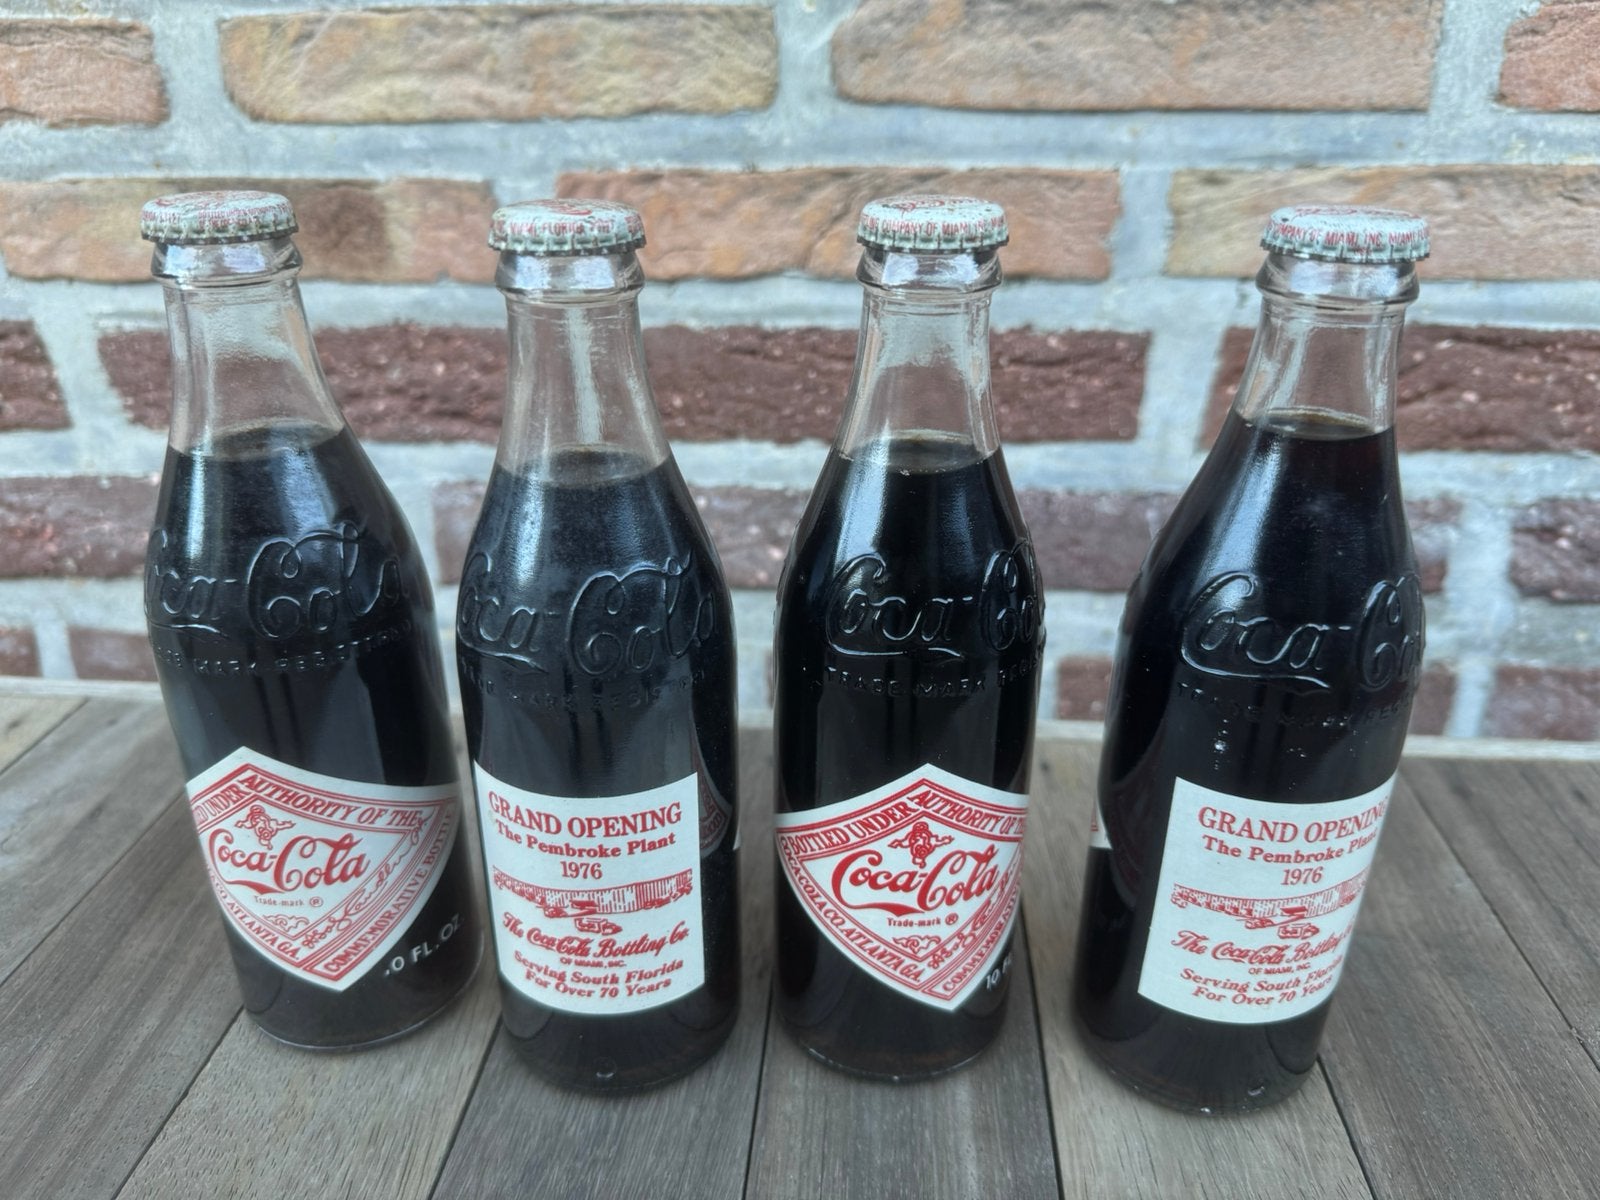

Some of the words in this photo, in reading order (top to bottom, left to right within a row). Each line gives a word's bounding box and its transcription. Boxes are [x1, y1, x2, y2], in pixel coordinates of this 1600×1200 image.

[203, 783, 251, 817] UNDER
[238, 774, 361, 821] AUTHORITY
[358, 806, 388, 826] OF
[386, 809, 423, 827] THE
[488, 791, 562, 835] GRAND
[567, 801, 682, 838] OPENING
[495, 818, 522, 844] The
[526, 834, 622, 858] Pembroke
[626, 832, 676, 856] Plant
[787, 827, 851, 855] BOTTLED
[844, 801, 920, 840] UNDER
[907, 789, 1004, 832] AUTHORITY
[999, 815, 1017, 835] OF
[1198, 806, 1299, 844] GRAND
[209, 828, 371, 895] Coca-Cola
[1202, 834, 1242, 858] The
[1247, 846, 1344, 864] Pembroke
[560, 861, 603, 880] 1976
[832, 844, 999, 917] Coca-Cola
[1281, 866, 1324, 886] 1976
[227, 902, 280, 946] ATLANTA
[323, 868, 428, 973] COMMEMORATIVE
[593, 933, 667, 957] Bottling
[840, 928, 906, 972] ATLANTA
[1171, 929, 1209, 955] The
[1211, 941, 1291, 965] Coca-Cola
[515, 950, 567, 984] Serving
[571, 971, 619, 985] South
[625, 960, 684, 984] Florida
[526, 968, 551, 989] For
[555, 981, 595, 998] Over
[600, 987, 620, 998] 70
[625, 979, 671, 997] Years
[1180, 968, 1250, 994] Serving
[1253, 977, 1301, 992] South
[1192, 986, 1226, 1002] For
[1231, 993, 1275, 1005] Over
[1278, 990, 1297, 1003] 70
